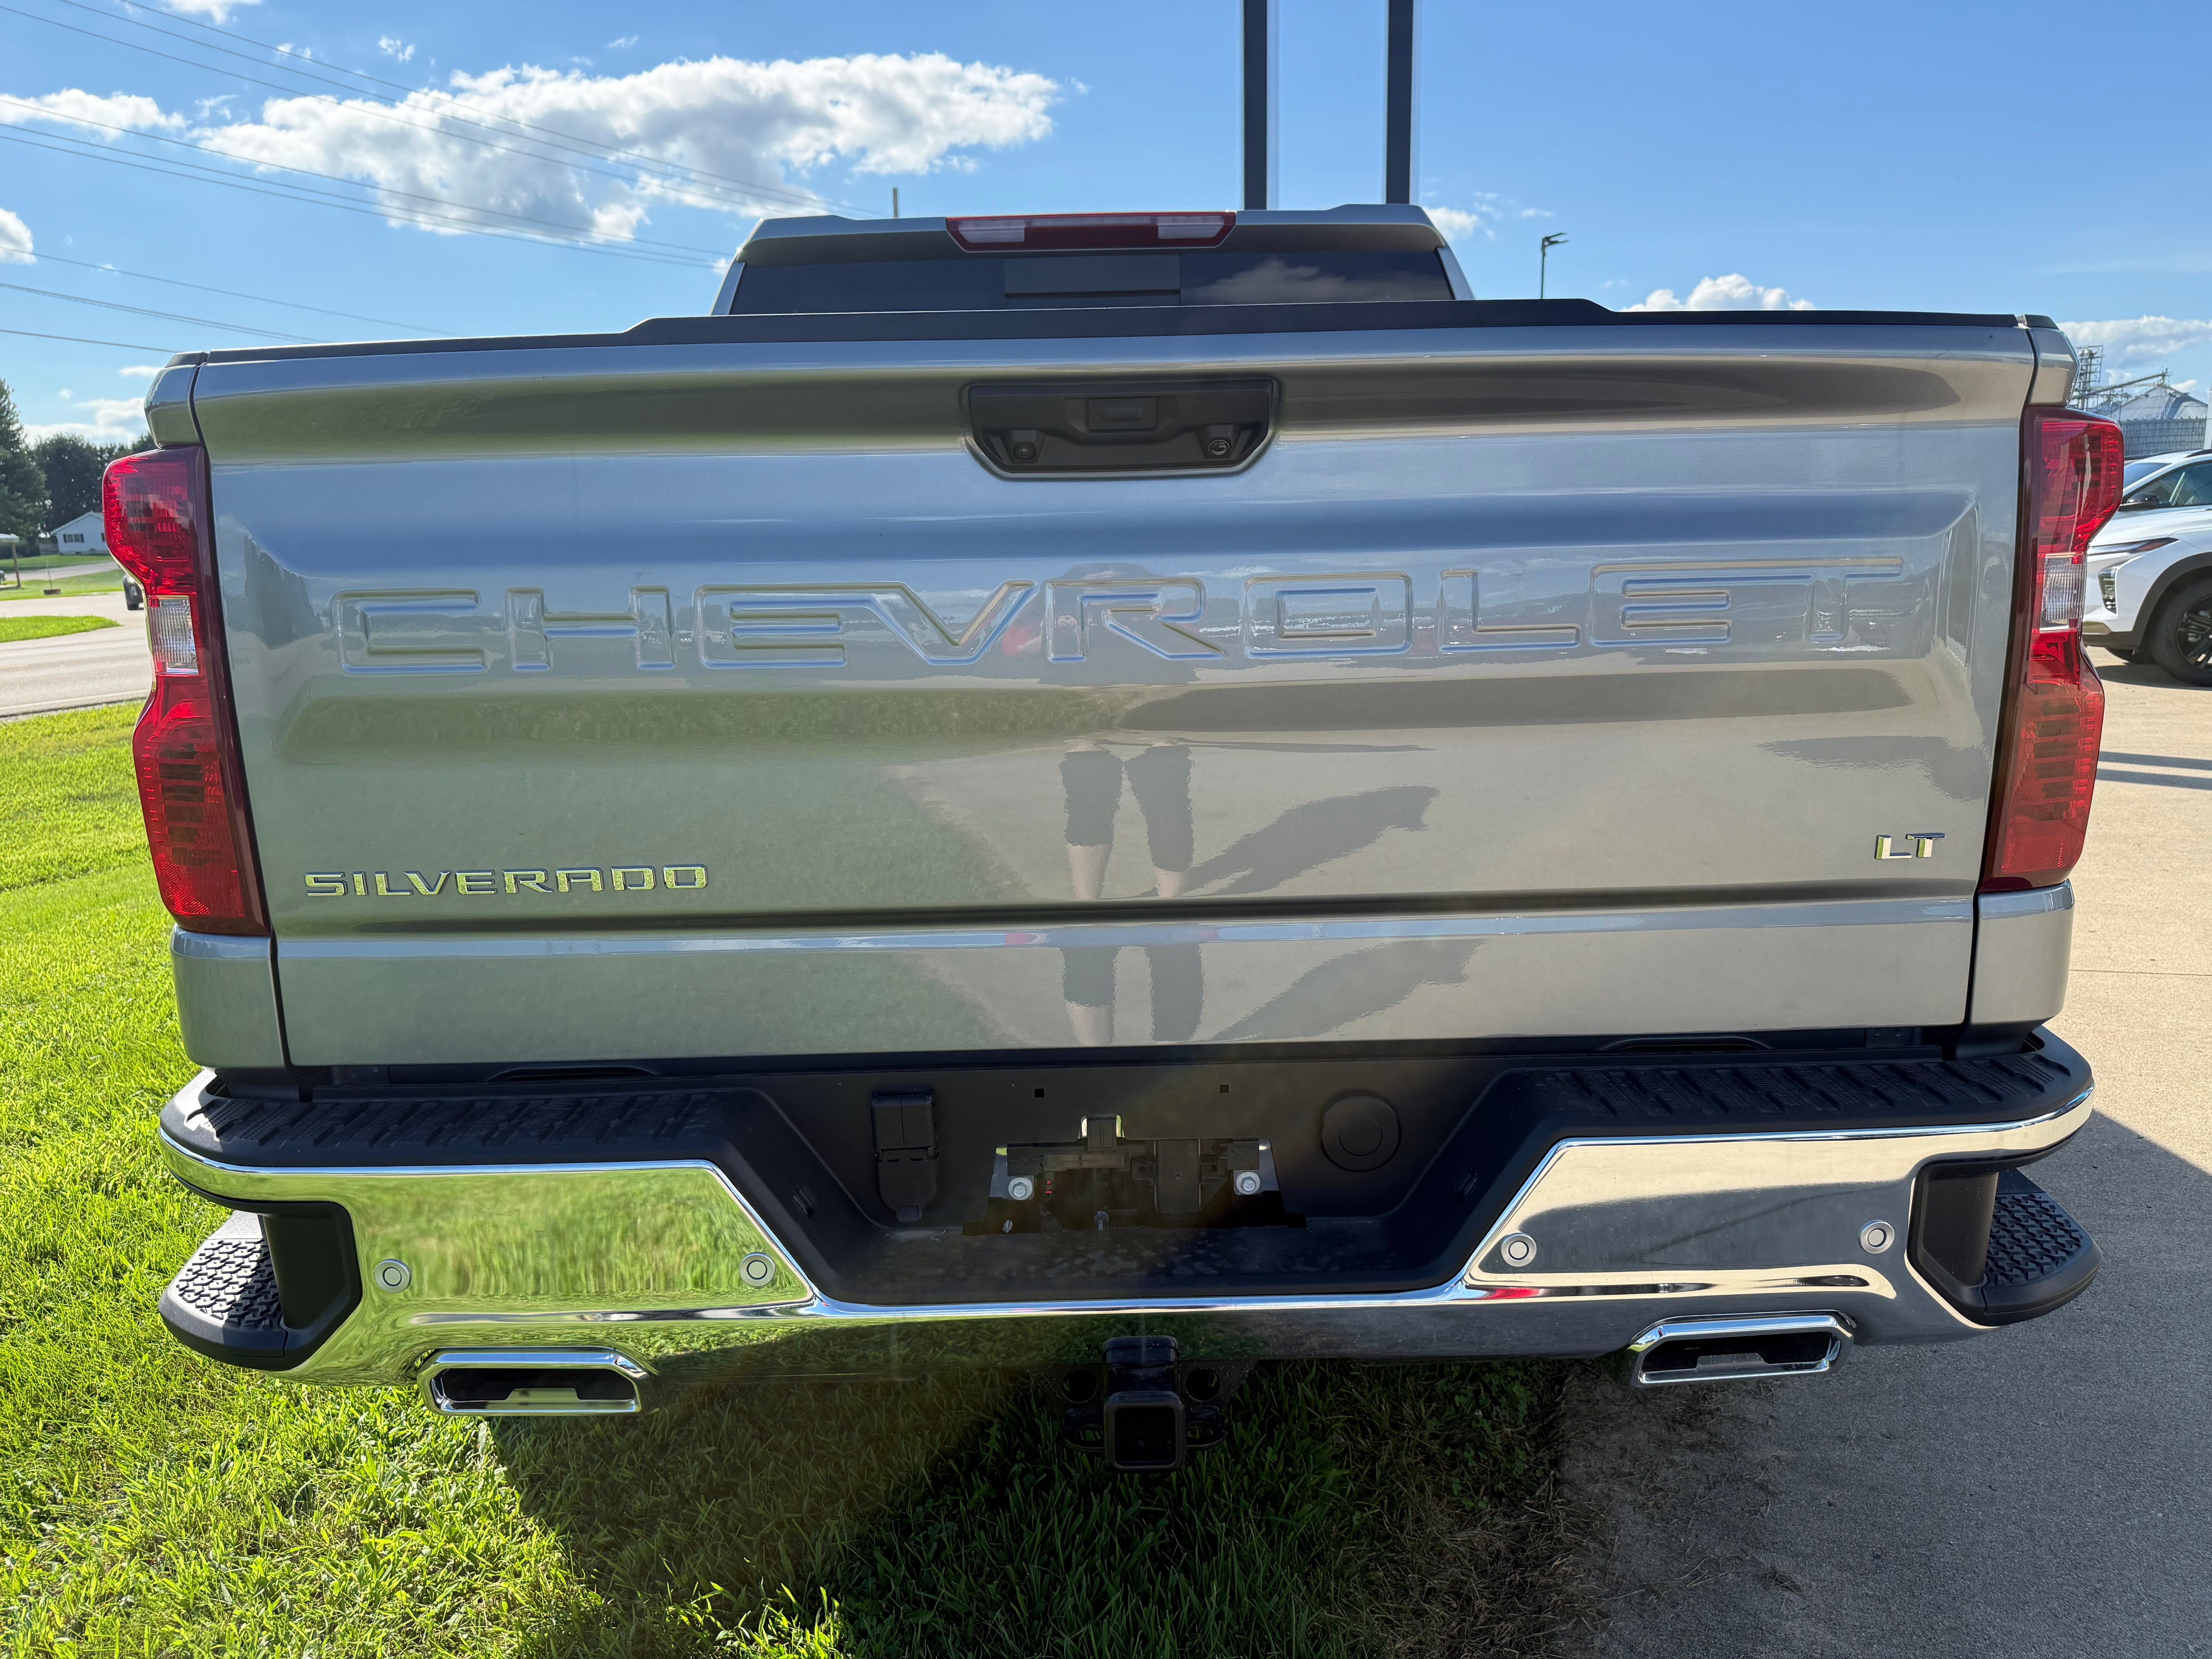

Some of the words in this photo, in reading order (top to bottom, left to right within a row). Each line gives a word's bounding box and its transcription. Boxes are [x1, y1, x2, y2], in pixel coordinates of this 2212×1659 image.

[332, 556, 1905, 674] CHEVROLET
[1875, 832, 1946, 860] LT
[304, 864, 708, 896] SILVERADO
